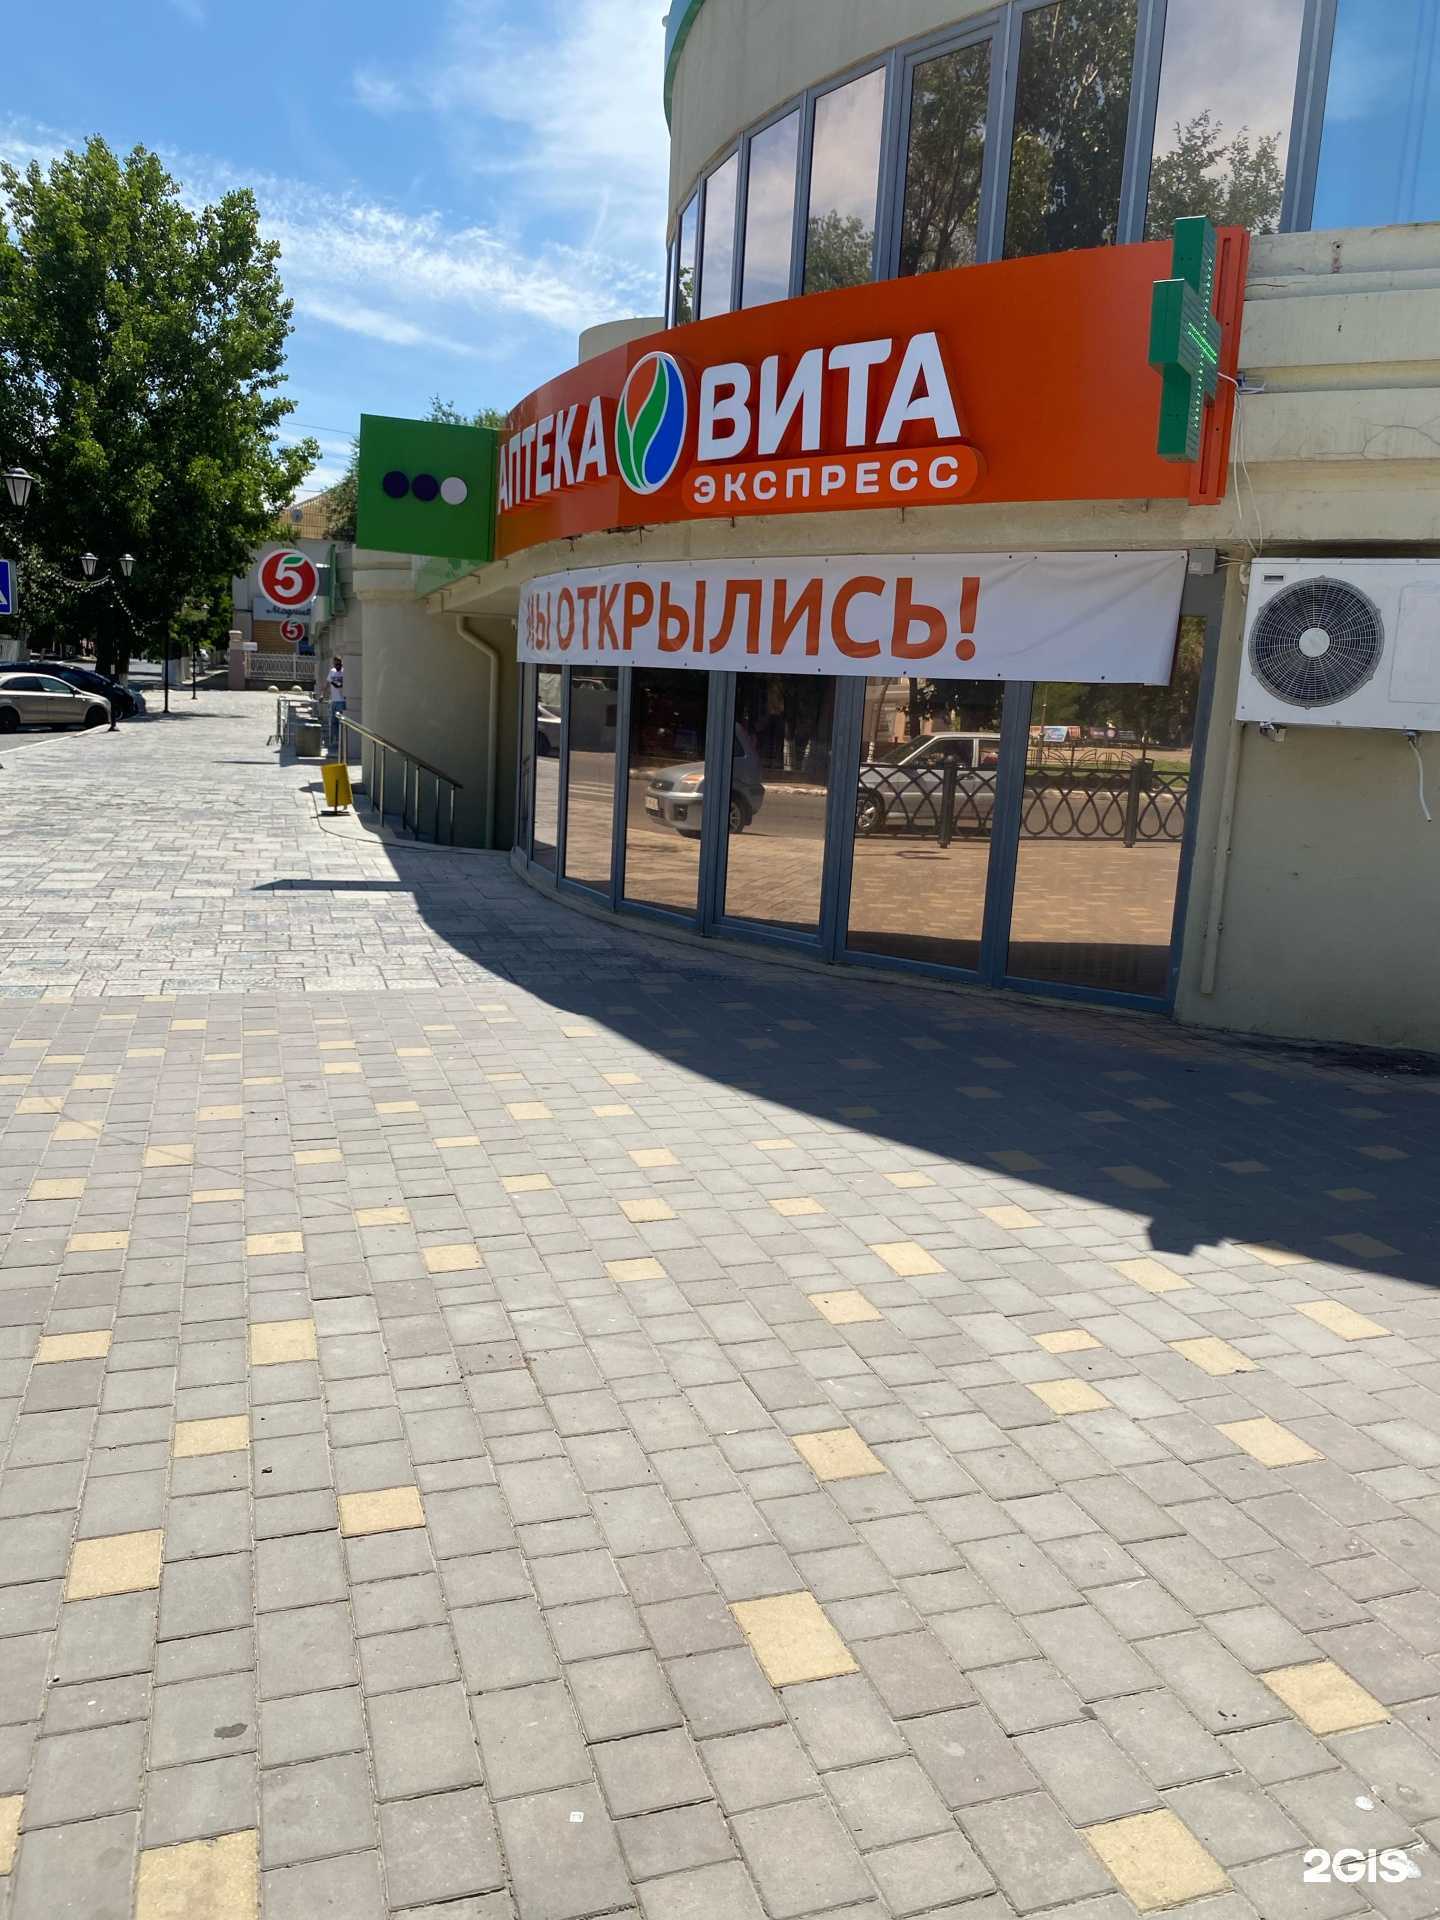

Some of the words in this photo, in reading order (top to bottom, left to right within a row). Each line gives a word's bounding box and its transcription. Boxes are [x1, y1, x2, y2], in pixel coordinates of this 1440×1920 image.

[497, 396, 608, 515] АПТЕКА
[697, 331, 962, 461] ВИТА
[693, 455, 959, 504] ЭКСПРЕСС
[557, 576, 981, 661] ОТКРЫЛИСЬ!
